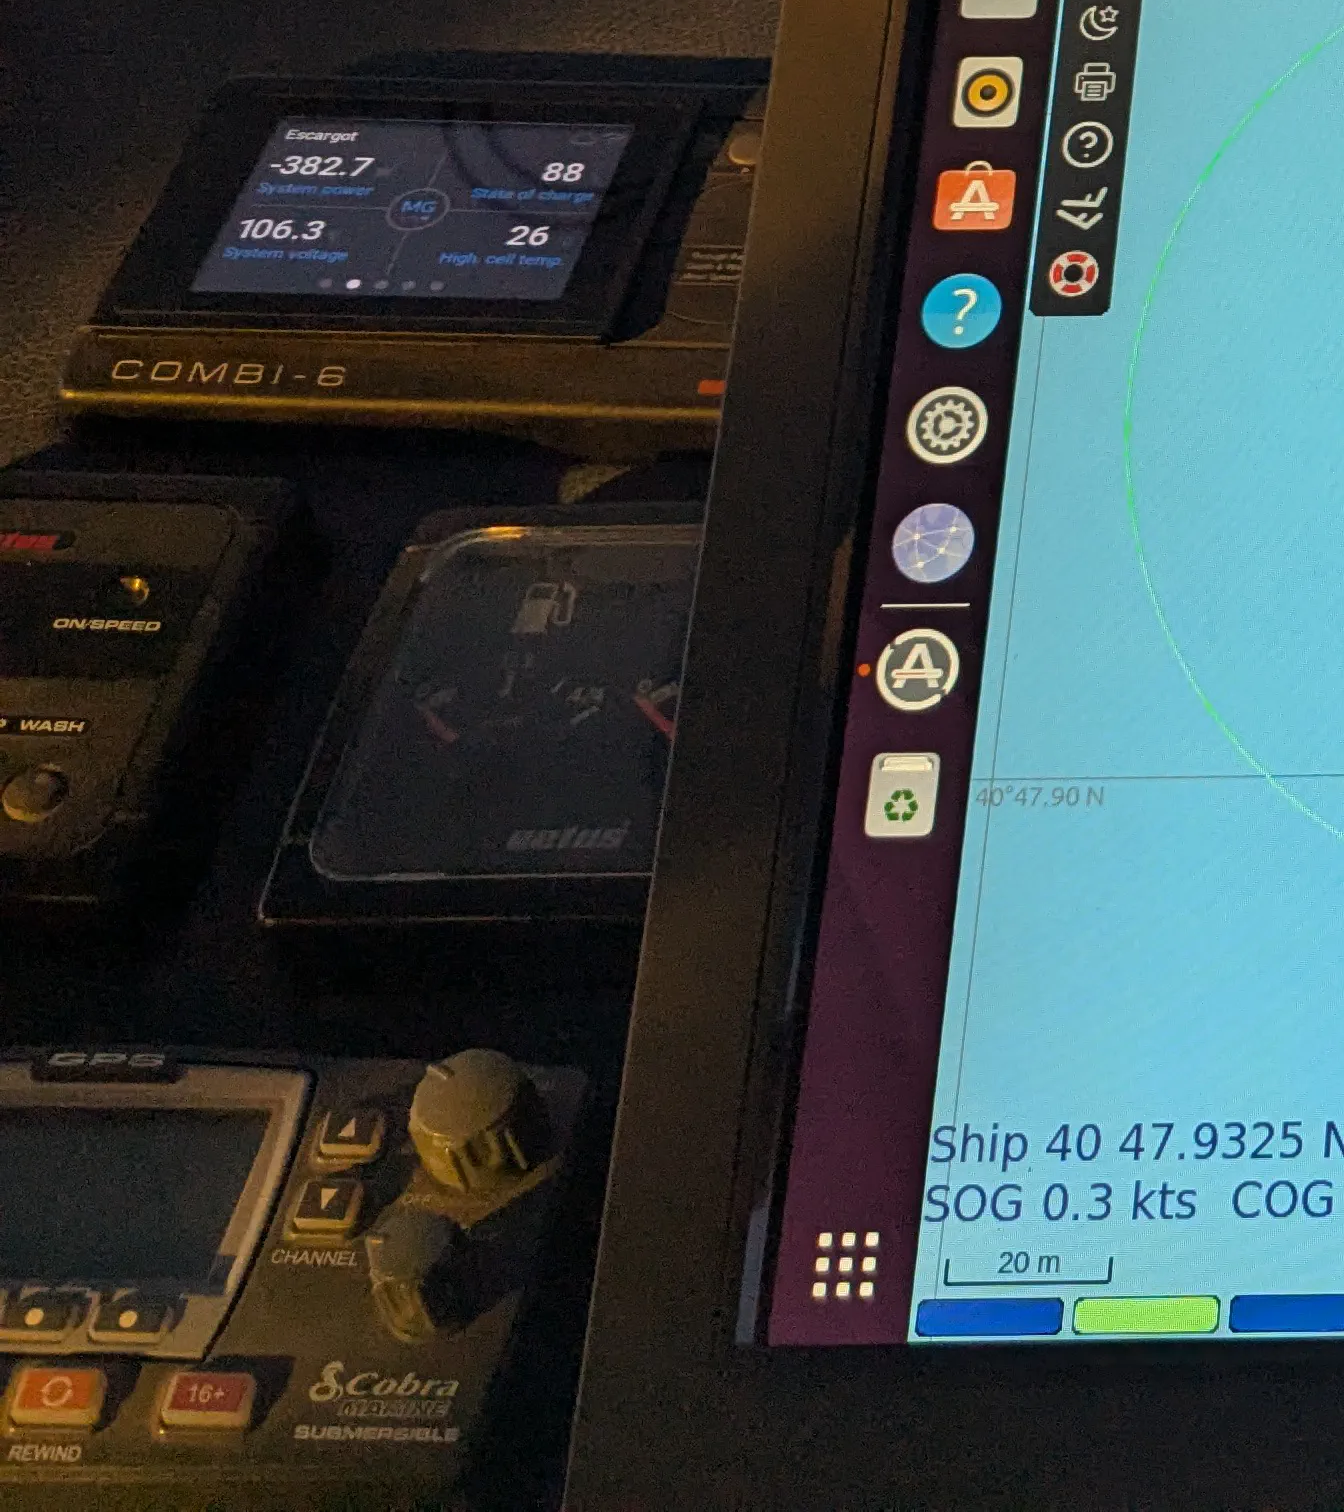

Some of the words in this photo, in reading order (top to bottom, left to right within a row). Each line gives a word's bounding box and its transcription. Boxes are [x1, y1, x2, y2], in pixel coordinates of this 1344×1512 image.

[285, 129, 359, 144] Escargot
[270, 155, 376, 178] -382.7
[541, 162, 585, 183] 88
[401, 200, 438, 214] MG
[240, 218, 326, 240] 106.3
[505, 225, 549, 246] 26
[111, 359, 347, 387] COMBI-6
[19, 718, 86, 733] WASH
[1085, 785, 1106, 808] N
[931, 1122, 1029, 1173] Ship
[1045, 1123, 1102, 1162] 40
[1118, 1121, 1303, 1161] 47.9325
[924, 1183, 1023, 1223] SOG
[1042, 1182, 1113, 1222] 0.3
[1131, 1179, 1198, 1221] kts
[1231, 1179, 1335, 1220] COG
[271, 1249, 359, 1267] CHANNEL
[997, 1251, 1031, 1274] 20
[1037, 1254, 1061, 1273] m
[188, 1383, 225, 1403] 16+
[345, 1371, 461, 1398] Cobra
[7, 1445, 82, 1462] REWIND
